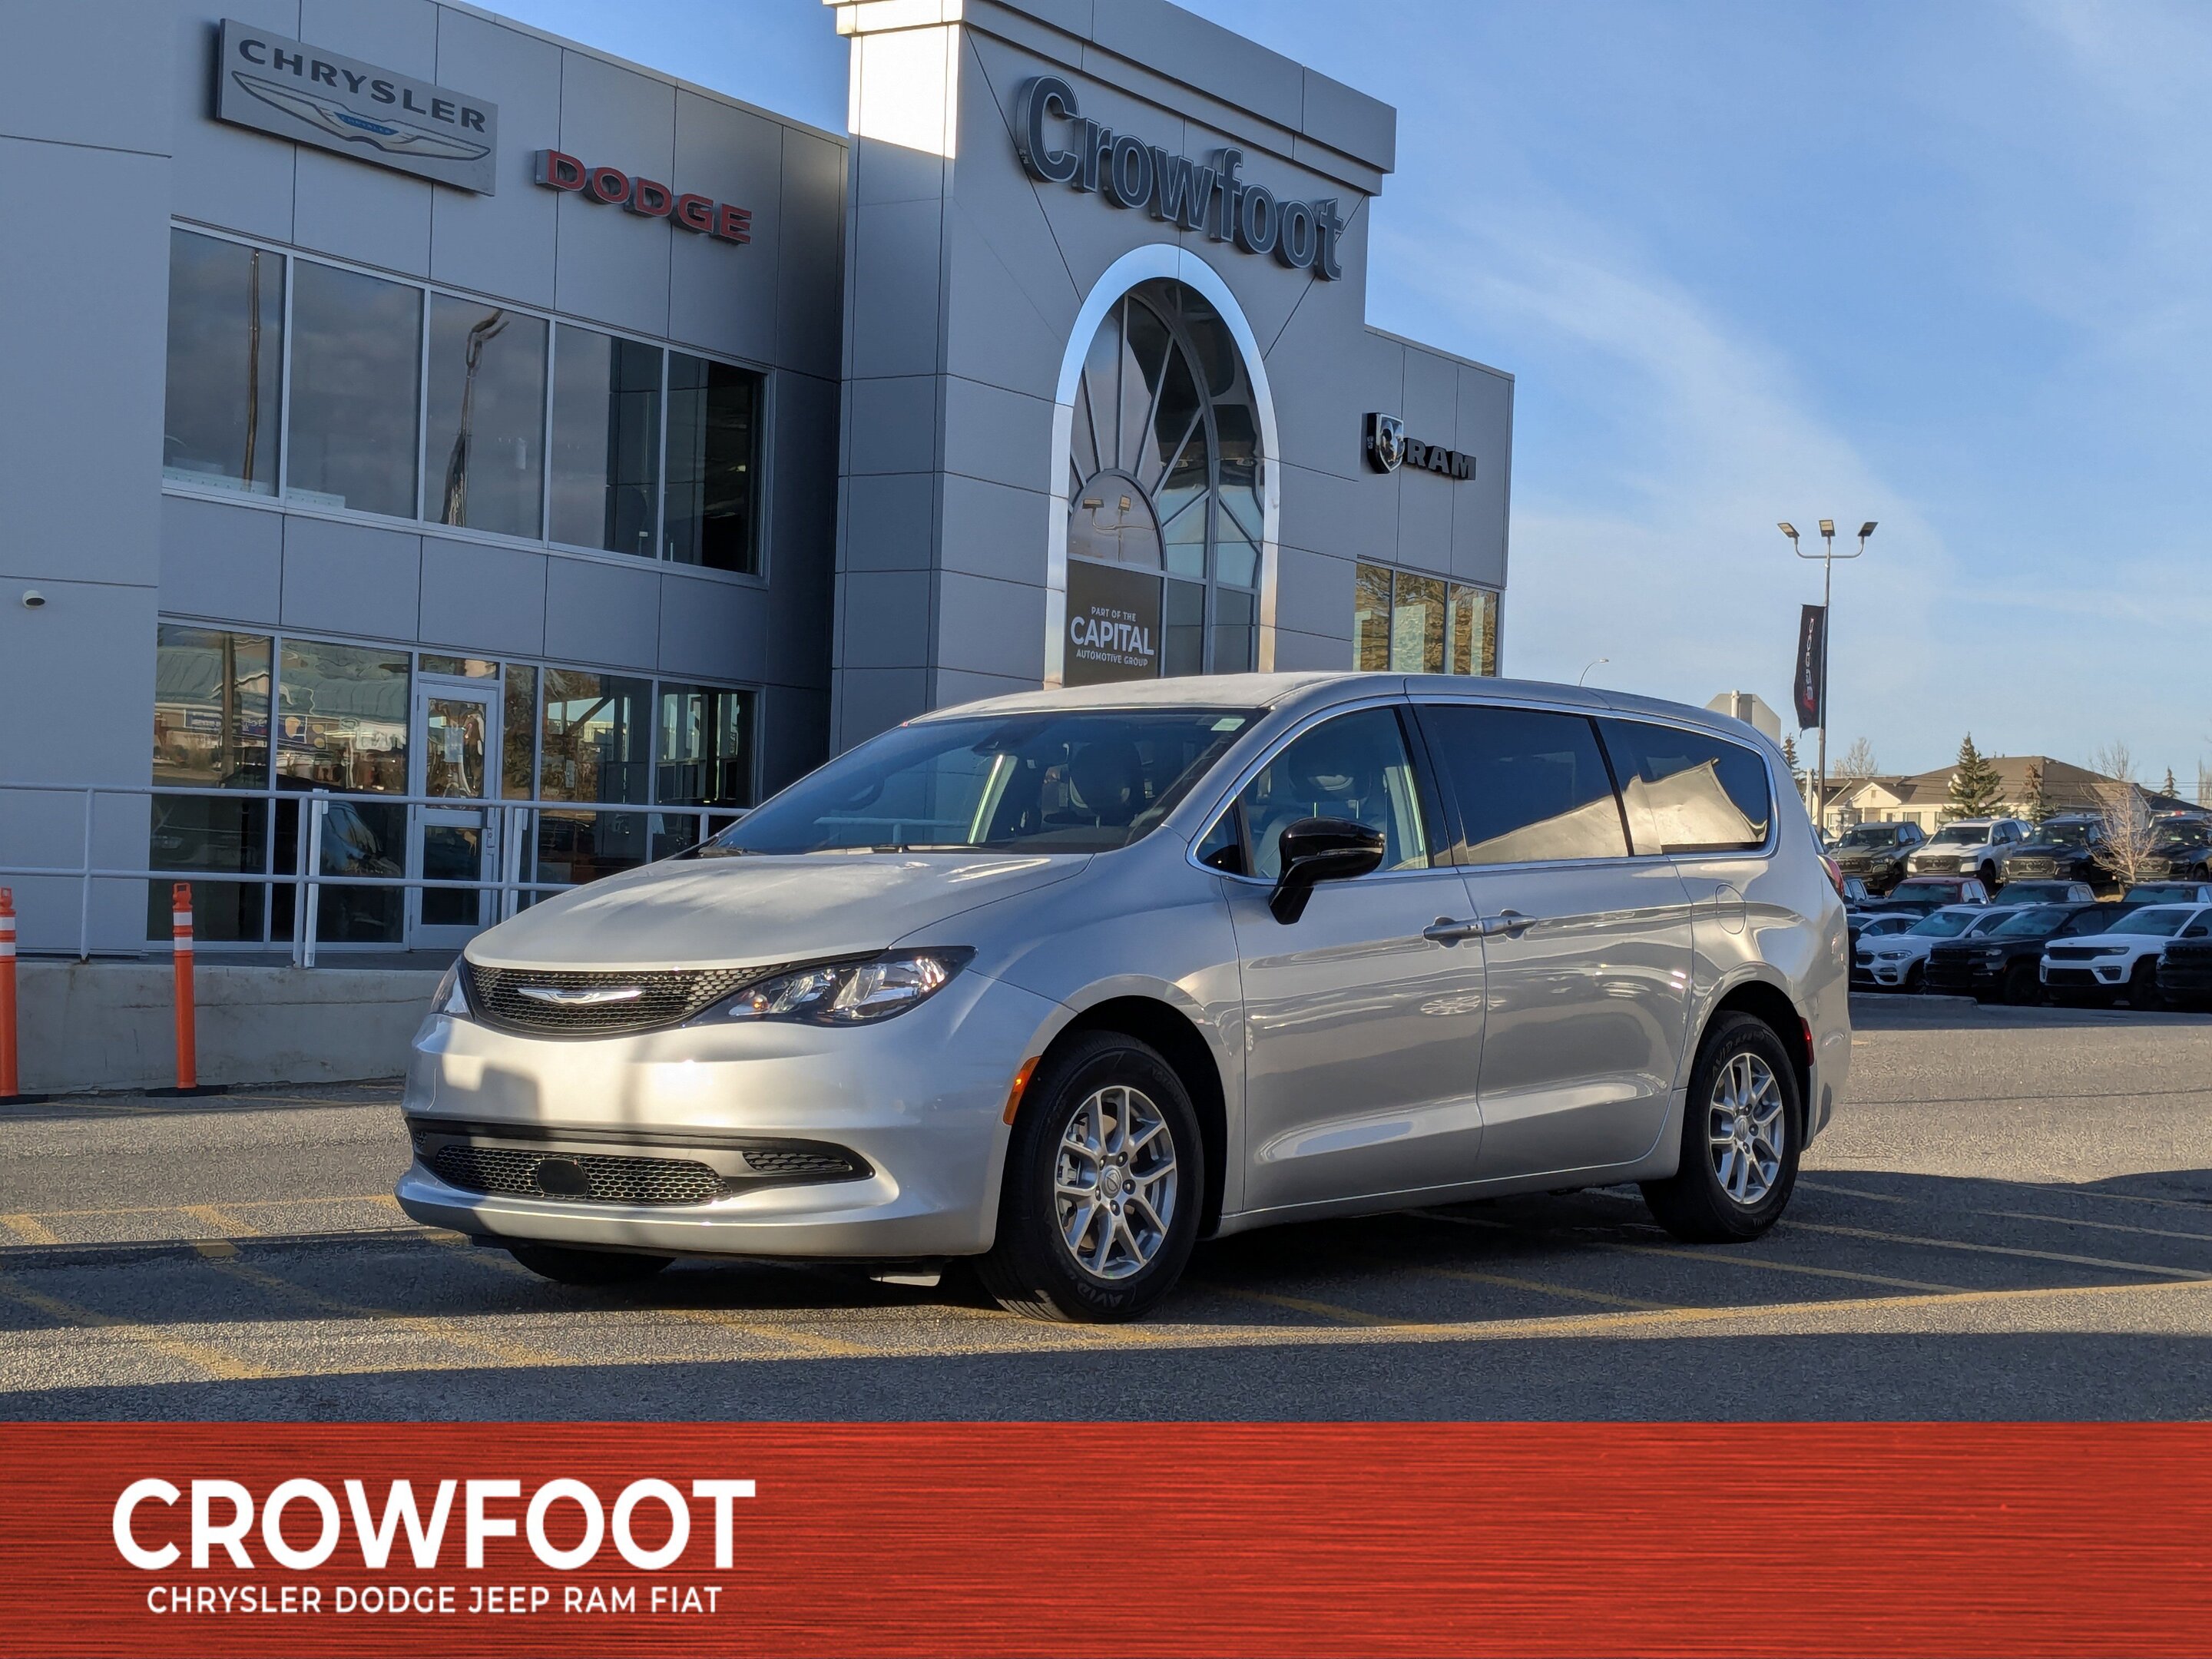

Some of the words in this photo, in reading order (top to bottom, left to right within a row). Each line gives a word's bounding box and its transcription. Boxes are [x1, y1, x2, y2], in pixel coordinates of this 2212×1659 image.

[238, 39, 486, 133] CHRYSLER
[546, 149, 752, 244] DODGE
[1026, 75, 1343, 281] Crowfoot
[1407, 438, 1476, 480] RAM
[1091, 606, 1110, 618] PART
[1111, 610, 1121, 620] OF
[1123, 612, 1137, 622] THE
[1070, 616, 1154, 656] CAPITAL
[1076, 648, 1122, 664] AUTOMOTIVE
[1124, 656, 1148, 667] GROUP
